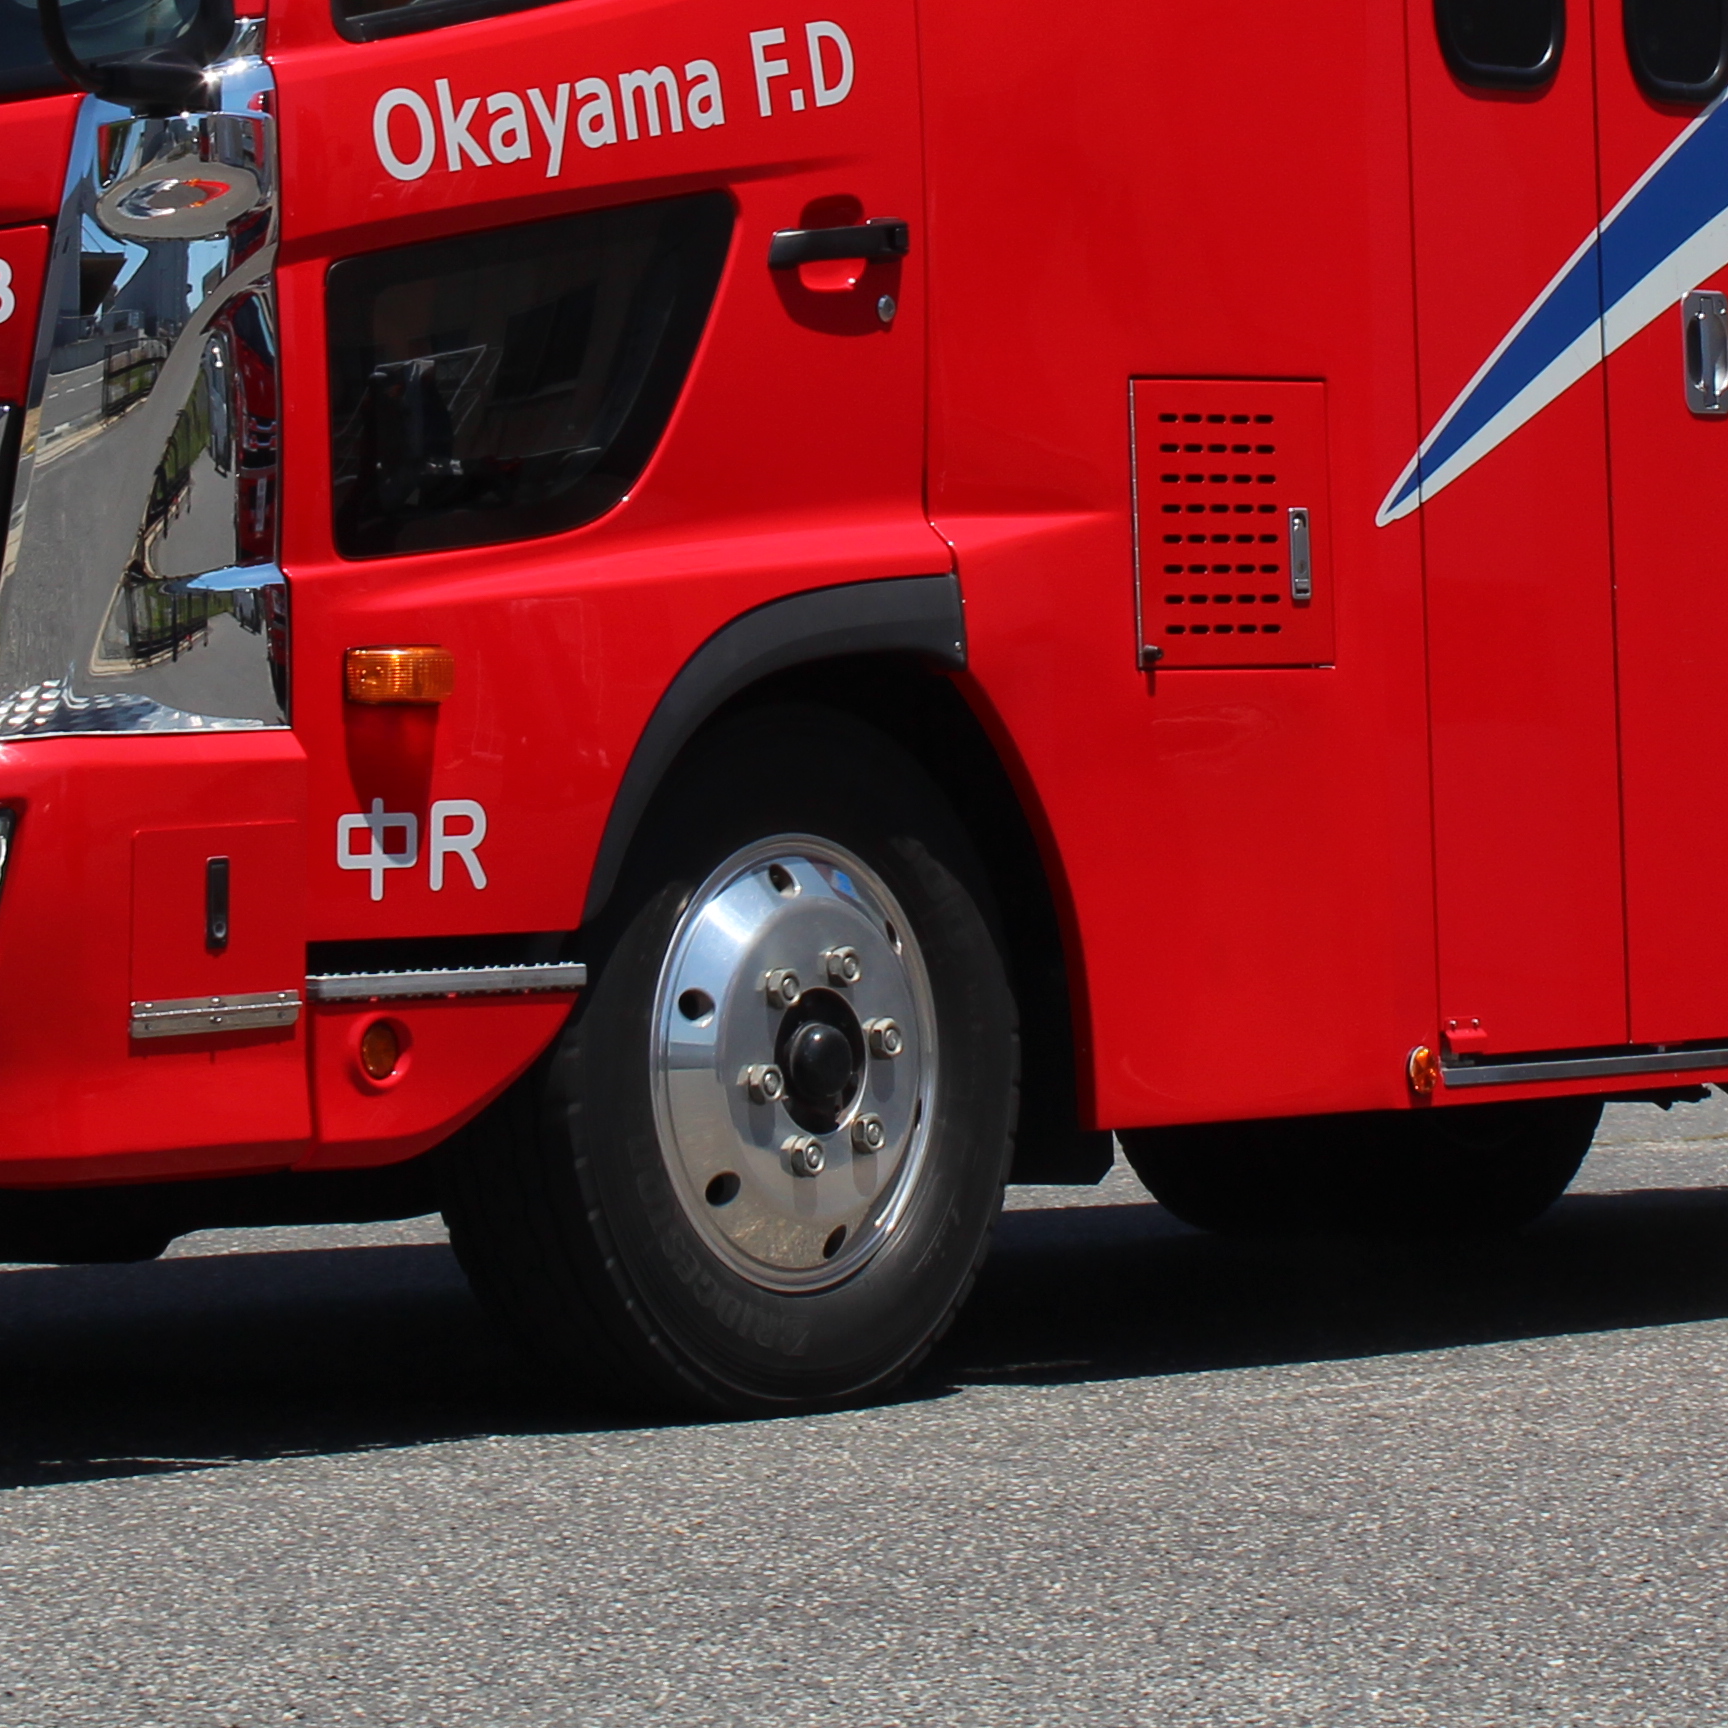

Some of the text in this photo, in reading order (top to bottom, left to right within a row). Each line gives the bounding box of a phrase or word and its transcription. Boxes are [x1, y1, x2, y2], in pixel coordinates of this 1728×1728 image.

[372, 20, 855, 181] Okayama F.D
[337, 797, 488, 902] 中R
